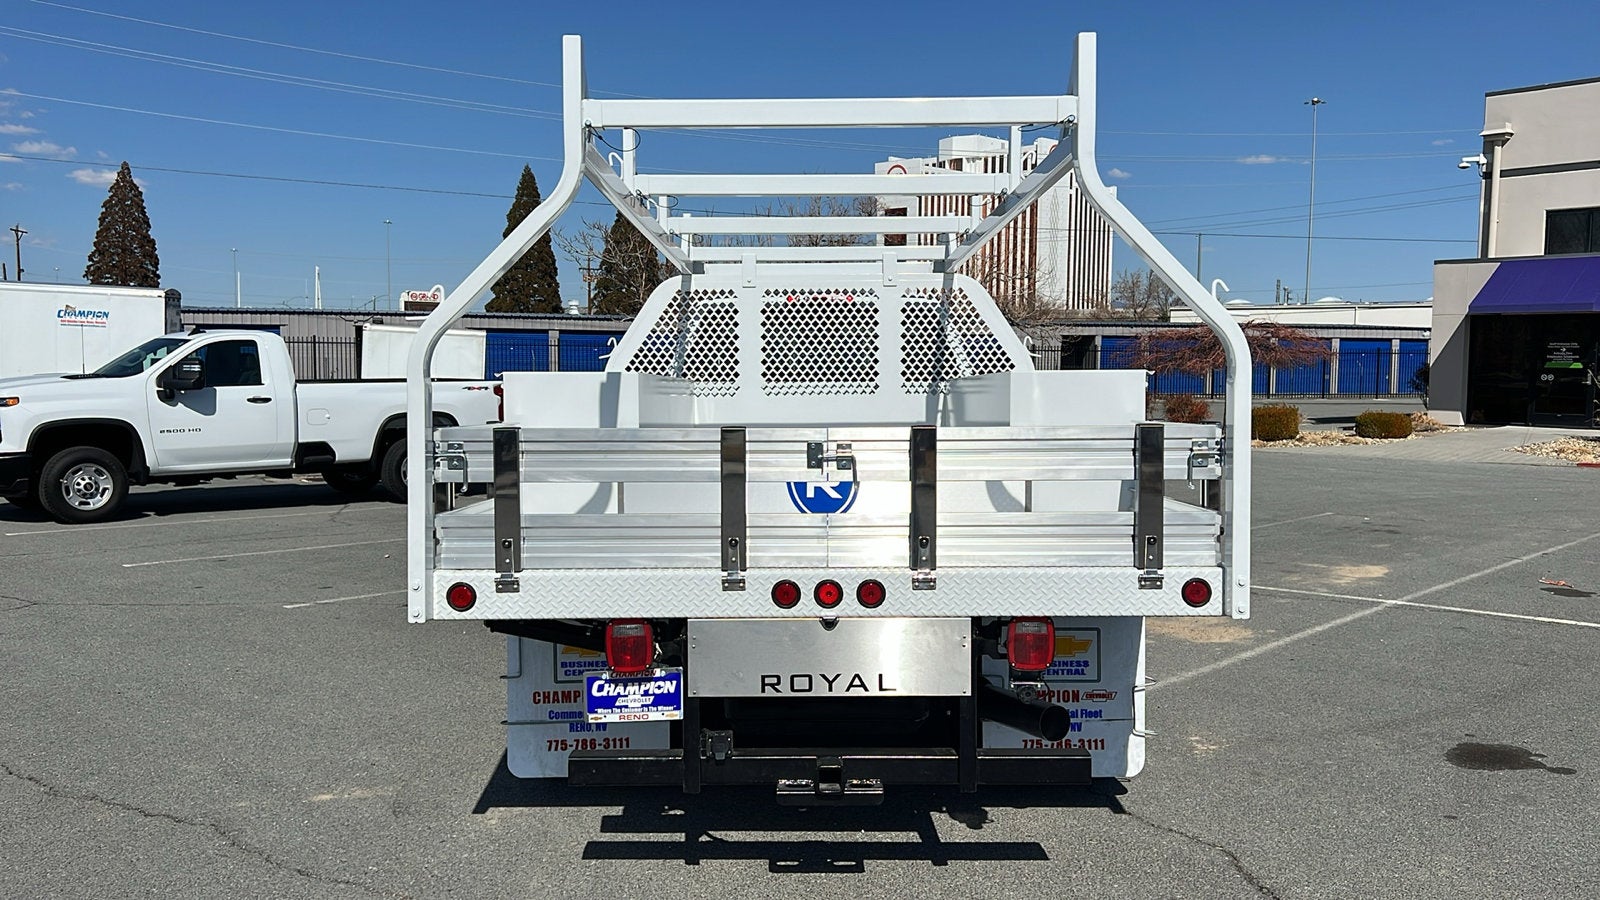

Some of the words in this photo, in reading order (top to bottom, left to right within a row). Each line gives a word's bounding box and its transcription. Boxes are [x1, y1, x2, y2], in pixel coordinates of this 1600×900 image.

[57, 309, 110, 319] CHAMPION
[560, 660, 608, 668] BUSINES
[1049, 660, 1090, 668] SINESS
[1043, 668, 1087, 676] ENTRAL
[591, 680, 677, 697] CHAMPION
[760, 673, 897, 694] ROYAL
[532, 690, 584, 705] CHAMP
[1036, 689, 1080, 703] MPION
[548, 709, 585, 720] Comme
[618, 713, 650, 721] RENO
[1080, 709, 1103, 719] Fleet
[547, 737, 630, 752] 775-786-3111
